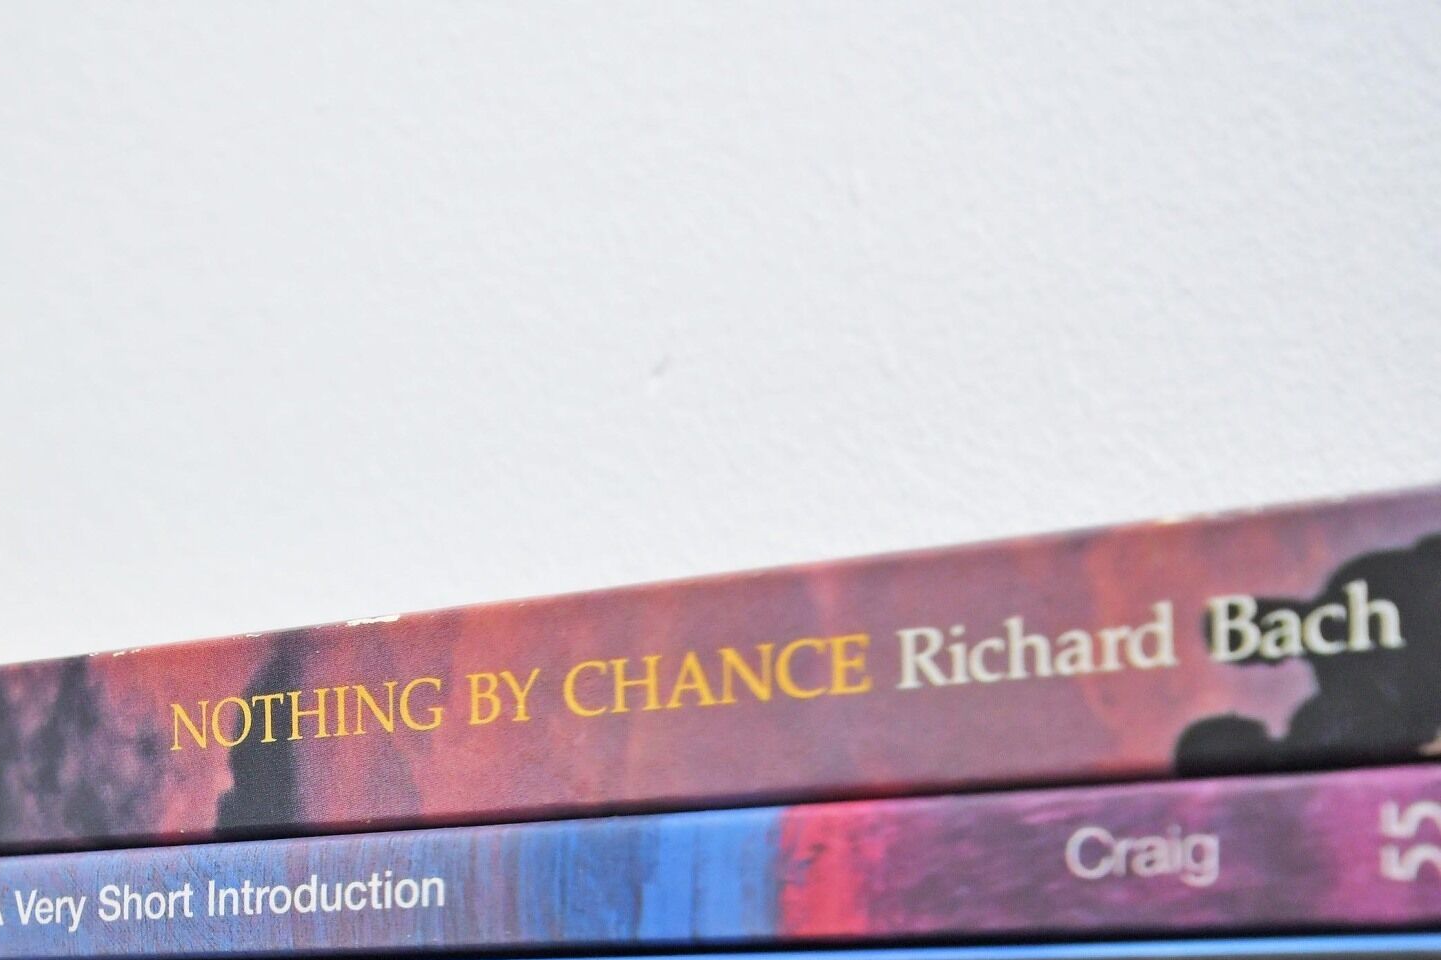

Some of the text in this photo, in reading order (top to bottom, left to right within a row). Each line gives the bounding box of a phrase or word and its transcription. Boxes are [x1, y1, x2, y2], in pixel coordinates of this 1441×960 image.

[170, 580, 1407, 751] NOTHING BY CHANCE Richard Bach
[1066, 826, 1220, 886] Craig
[15, 889, 86, 932] Very
[98, 883, 194, 921] Short
[208, 870, 445, 917] Introduction
